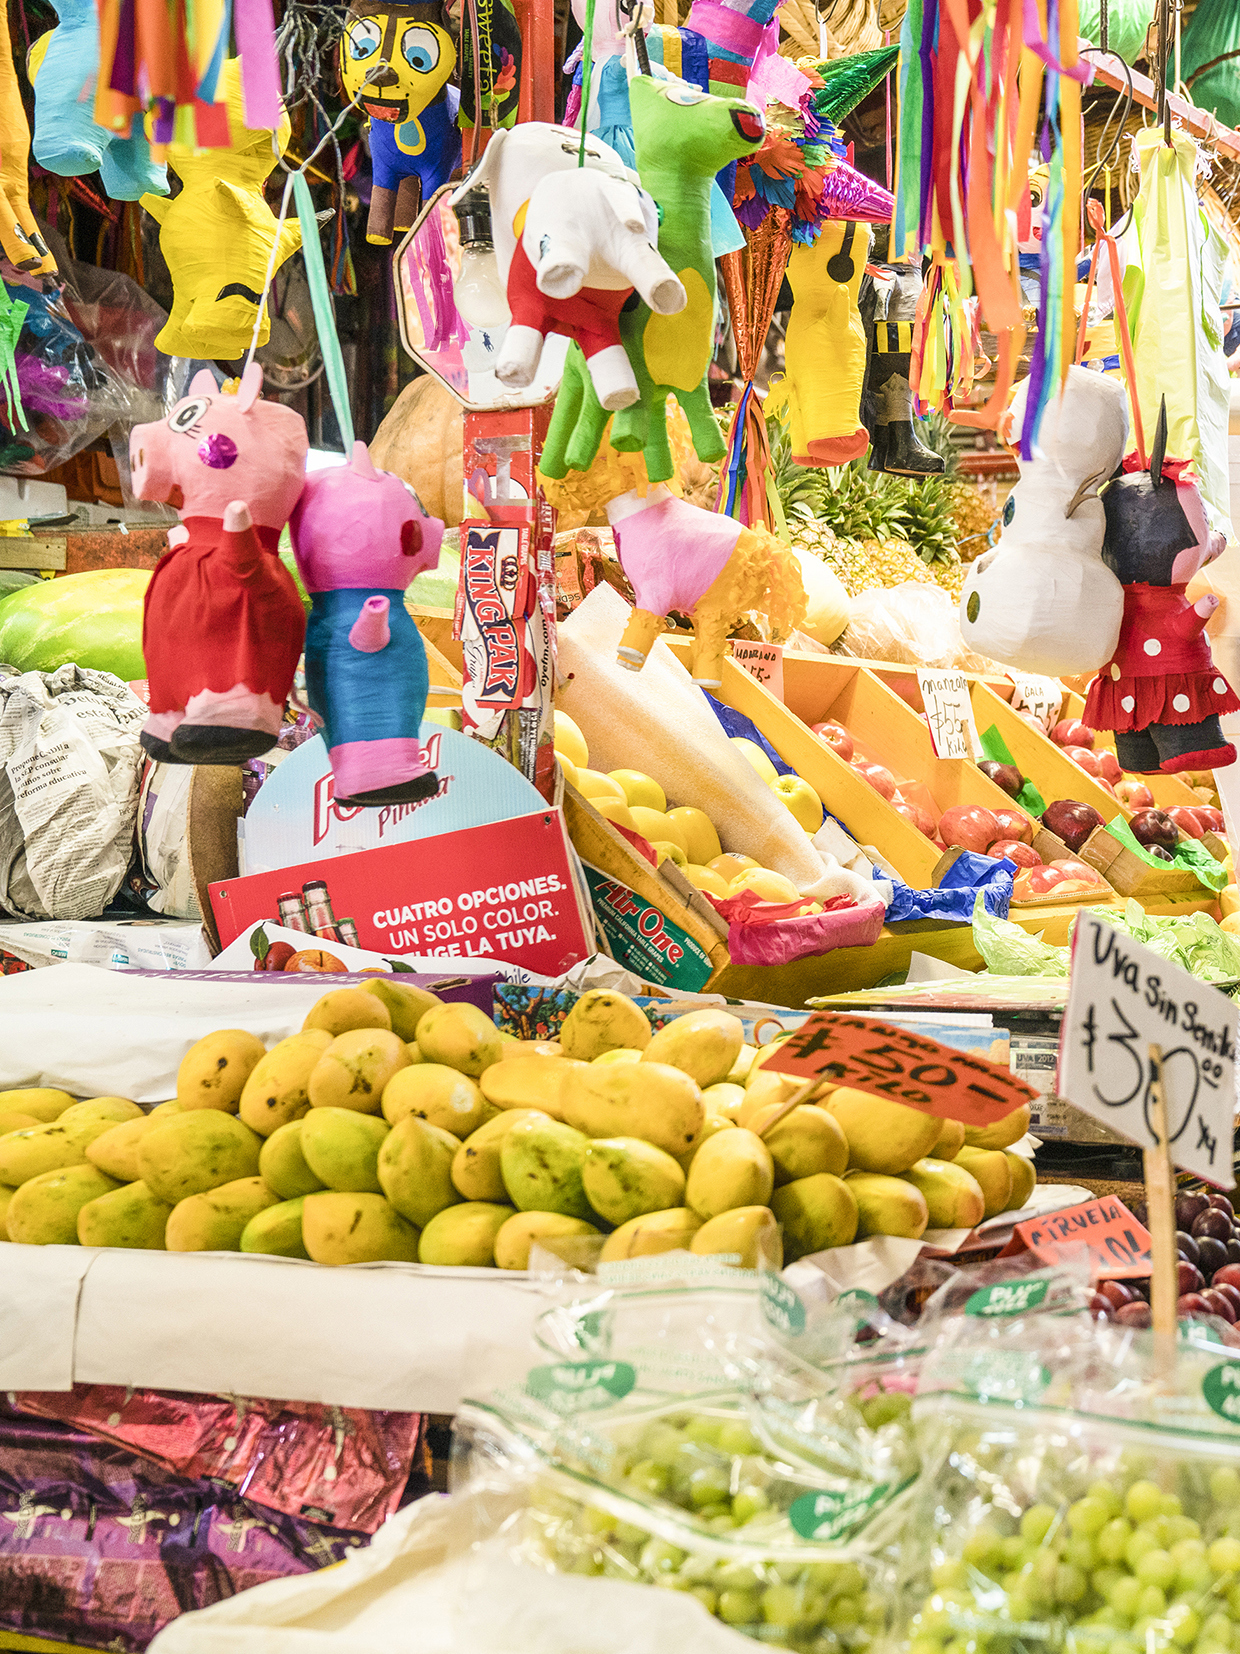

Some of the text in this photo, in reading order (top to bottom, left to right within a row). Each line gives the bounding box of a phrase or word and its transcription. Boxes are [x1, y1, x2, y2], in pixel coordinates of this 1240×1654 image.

[467, 545, 518, 690] KING PAK
[372, 874, 567, 929] CUATRO OPCIONES.
[389, 899, 560, 949] UN SOLO COLOR.
[594, 880, 641, 917] Air
[637, 907, 684, 965] One
[465, 936, 494, 957] LA
[495, 924, 557, 950] TUYA.
[1090, 921, 1139, 995] Uva
